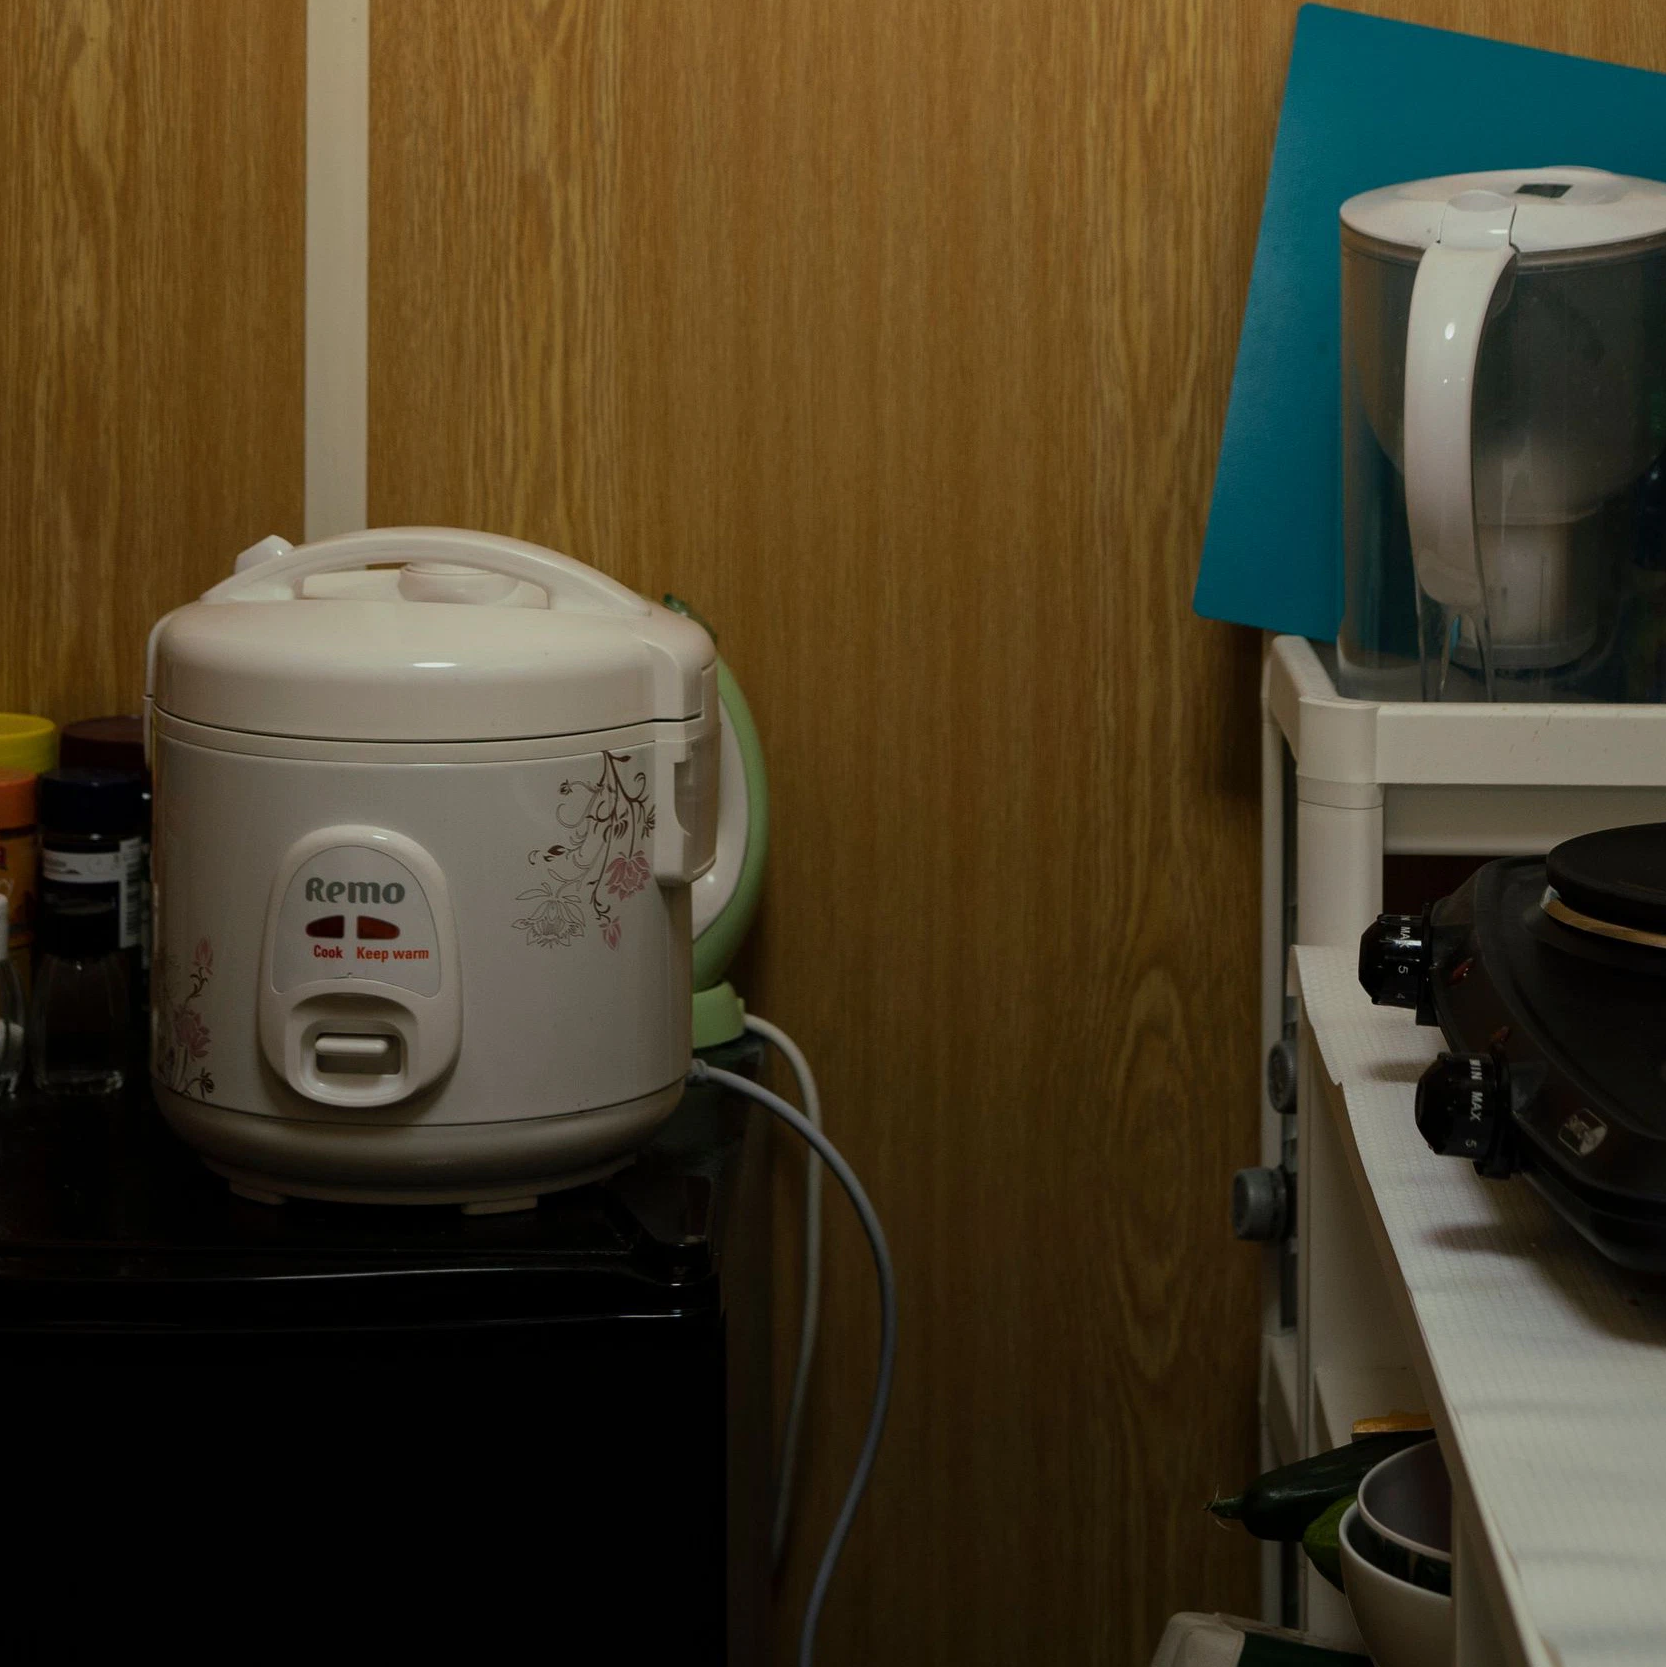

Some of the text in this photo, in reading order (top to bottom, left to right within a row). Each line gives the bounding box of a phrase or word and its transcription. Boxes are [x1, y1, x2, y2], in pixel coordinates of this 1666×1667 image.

[305, 877, 405, 904] Remo
[313, 945, 429, 962] Cook Keep warm
[1469, 1091, 1484, 1122] MAX
